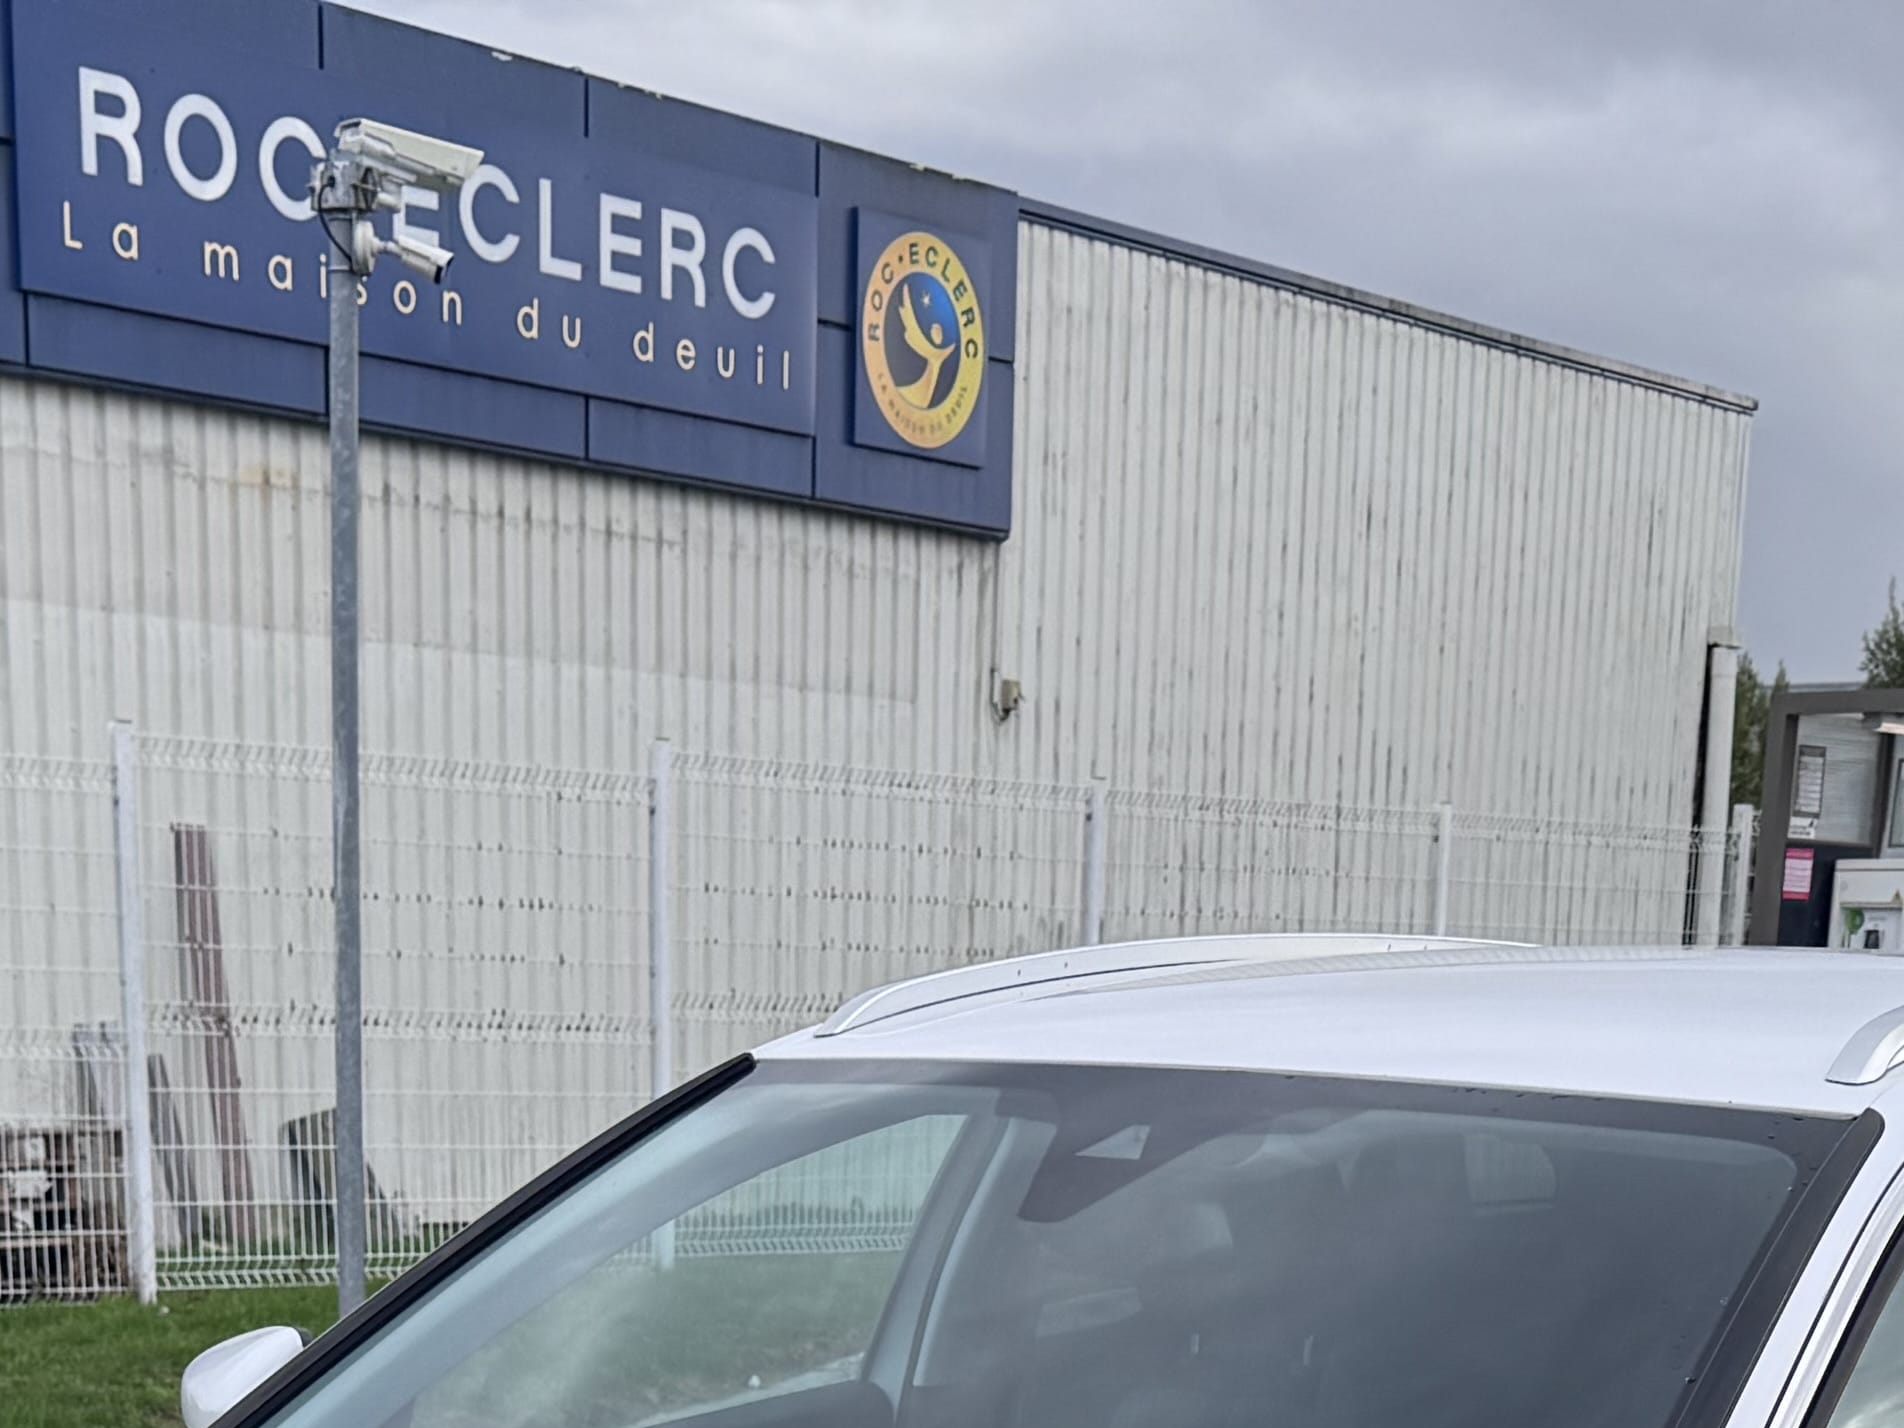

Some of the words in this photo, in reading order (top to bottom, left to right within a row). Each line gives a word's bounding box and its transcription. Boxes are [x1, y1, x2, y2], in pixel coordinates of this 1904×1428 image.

[62, 200, 139, 261] La
[517, 297, 582, 349] du
[633, 321, 789, 390] deuil
